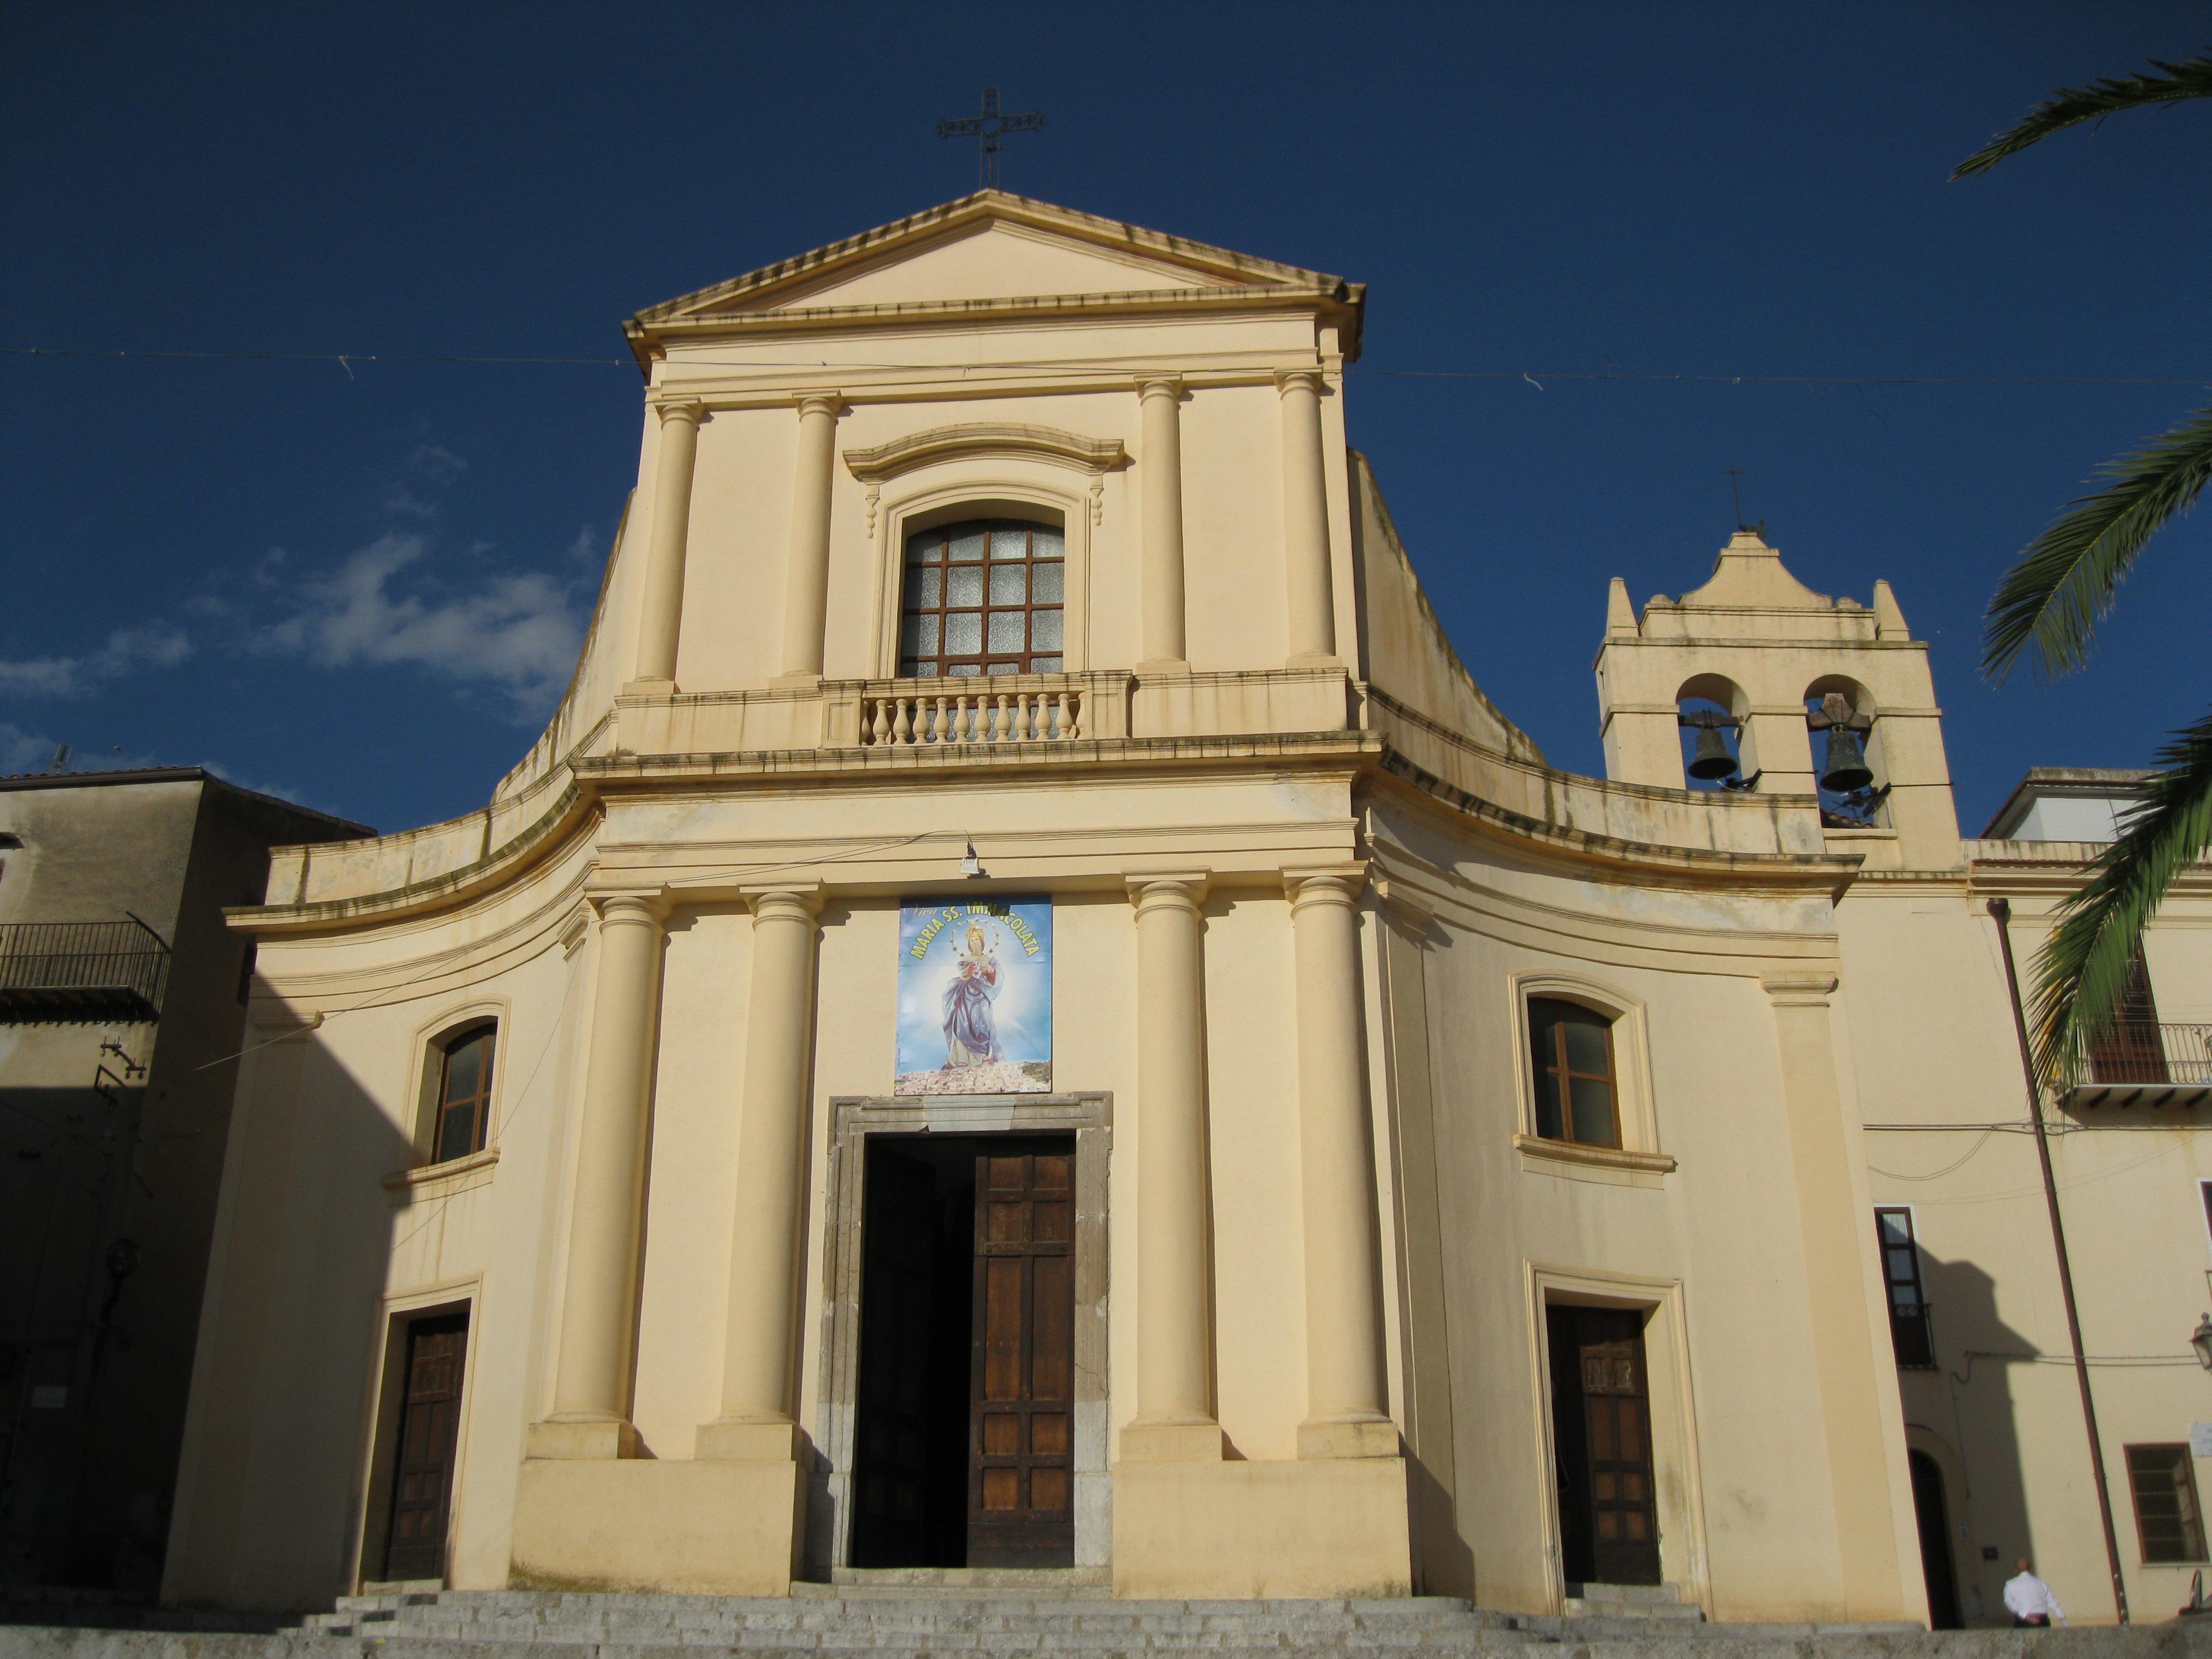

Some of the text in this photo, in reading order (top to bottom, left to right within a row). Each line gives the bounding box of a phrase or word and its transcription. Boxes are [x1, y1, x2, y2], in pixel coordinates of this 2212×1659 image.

[903, 903, 938, 916] Viva
[910, 901, 1041, 959] MARIA SS. IMMACOLATA
